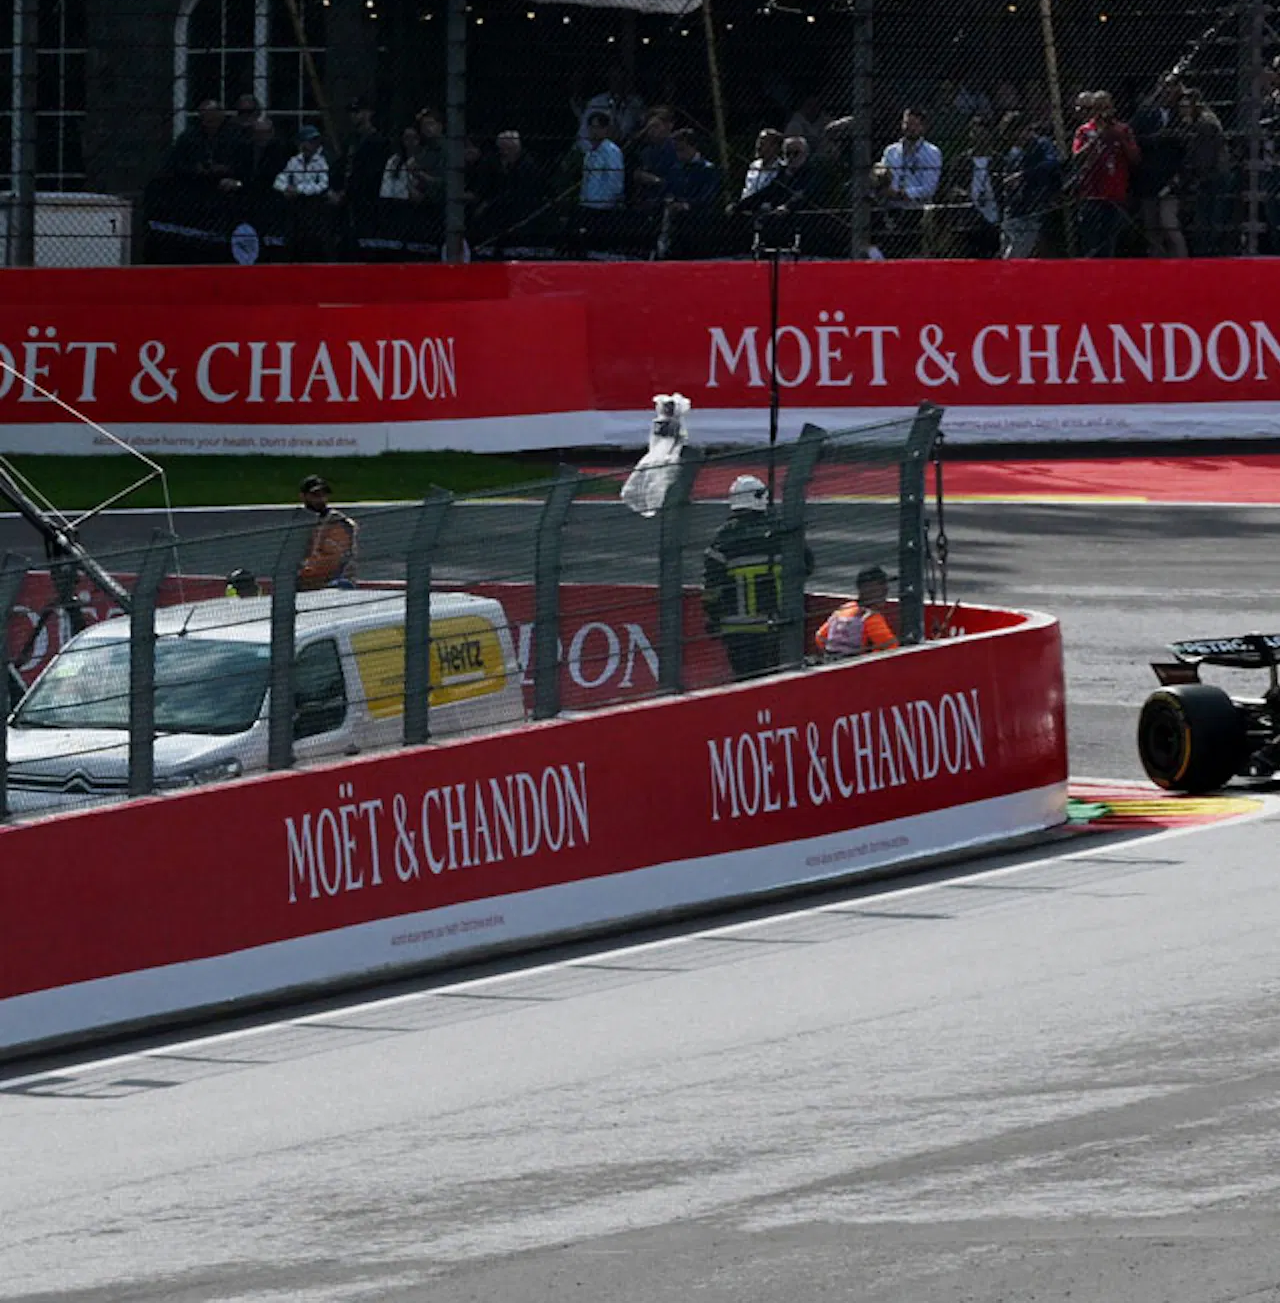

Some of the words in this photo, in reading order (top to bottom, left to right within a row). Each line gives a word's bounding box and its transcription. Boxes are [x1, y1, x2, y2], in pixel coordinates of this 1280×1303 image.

[130, 340, 178, 404] &
[196, 337, 457, 403] CHANDON
[706, 310, 900, 388] MOËT
[915, 323, 960, 387] &
[437, 635, 484, 674] Hertz
[707, 707, 801, 821] MOËT
[807, 718, 832, 806] &
[831, 688, 986, 796] CHANDON
[284, 779, 383, 904] MOËT
[393, 793, 421, 882] &
[421, 762, 591, 875] CHANDON
